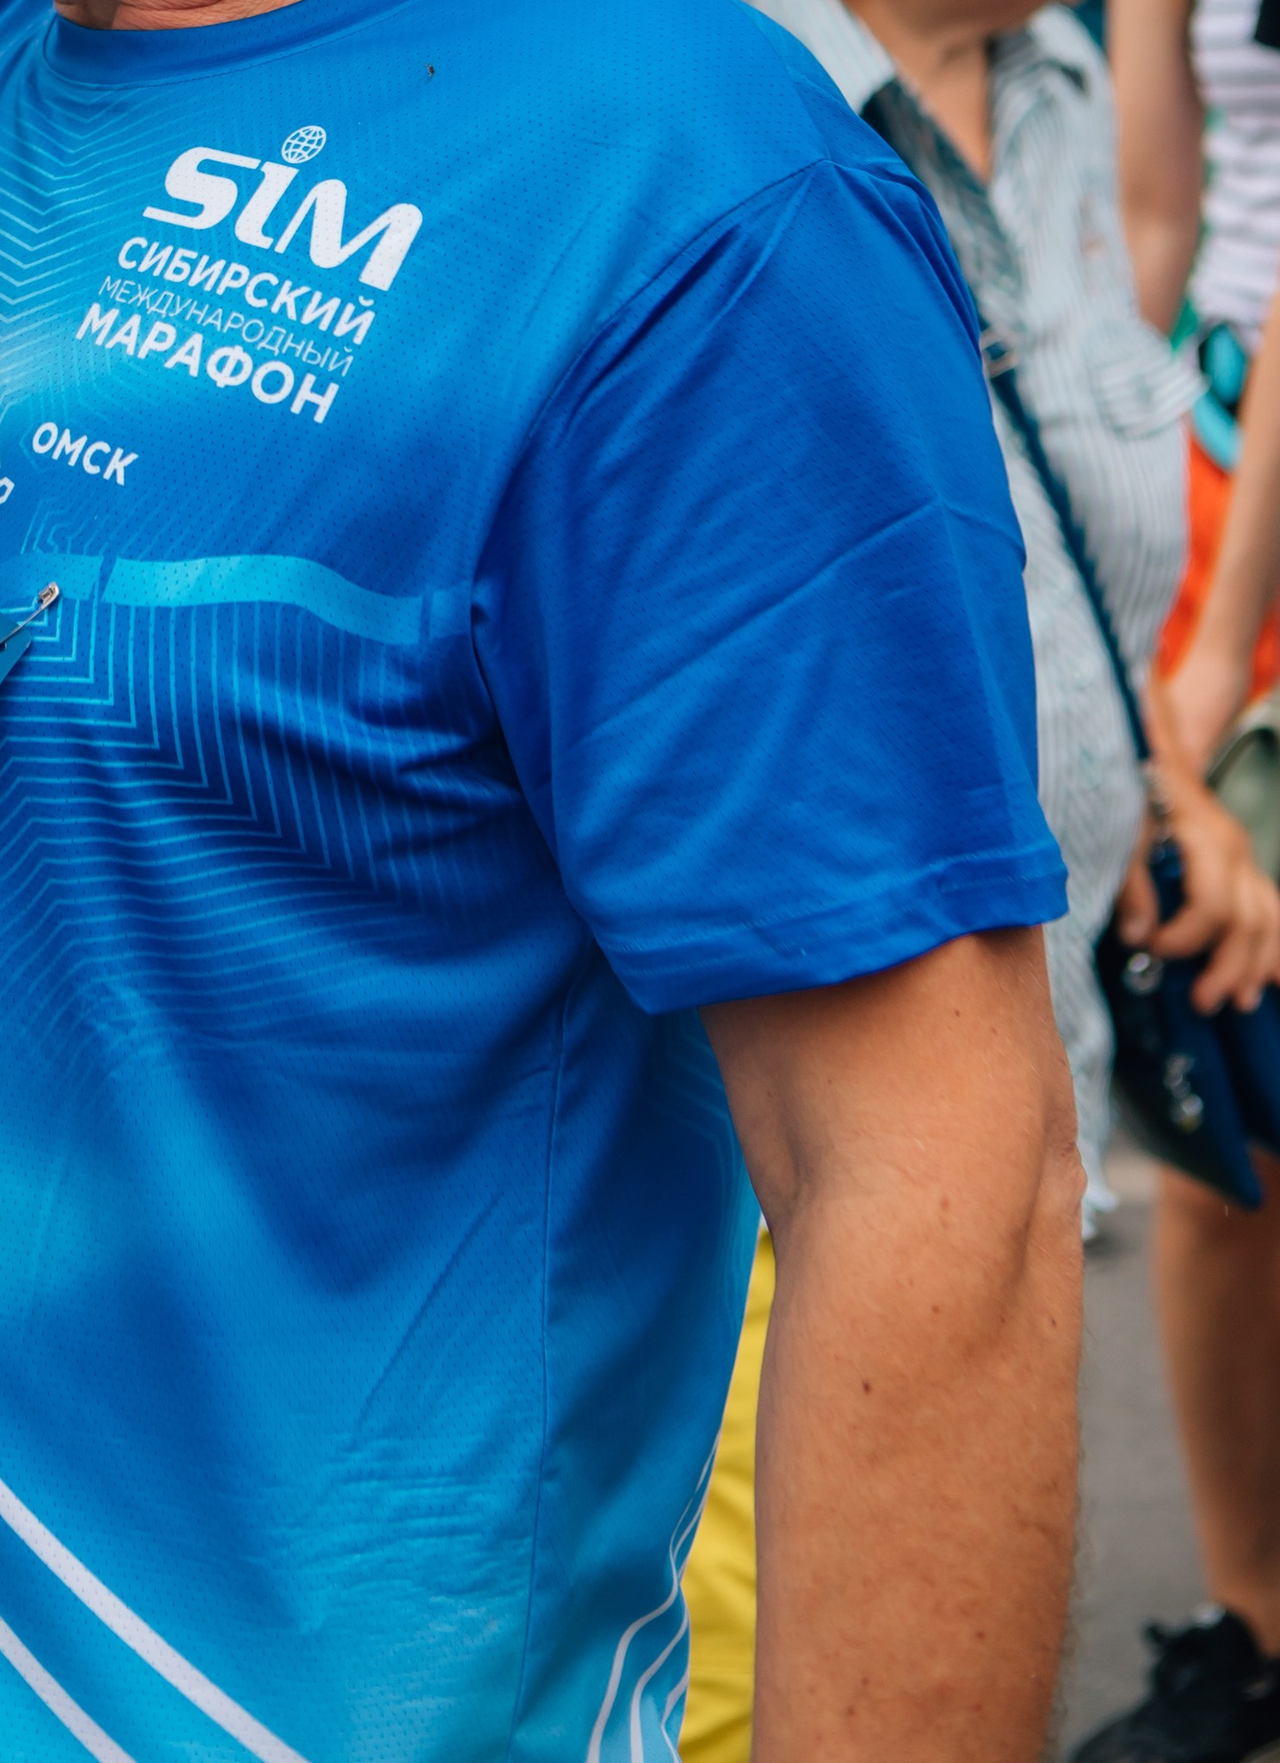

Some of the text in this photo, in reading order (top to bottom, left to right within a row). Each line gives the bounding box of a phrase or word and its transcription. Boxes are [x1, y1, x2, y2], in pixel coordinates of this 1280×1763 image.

[98, 276, 355, 378] МЕЖДУНАРОДНЫЙ
[118, 236, 376, 346] СИБИРСКИЙ
[75, 302, 340, 424] МАРАФОН
[31, 421, 139, 486] ОМСК
